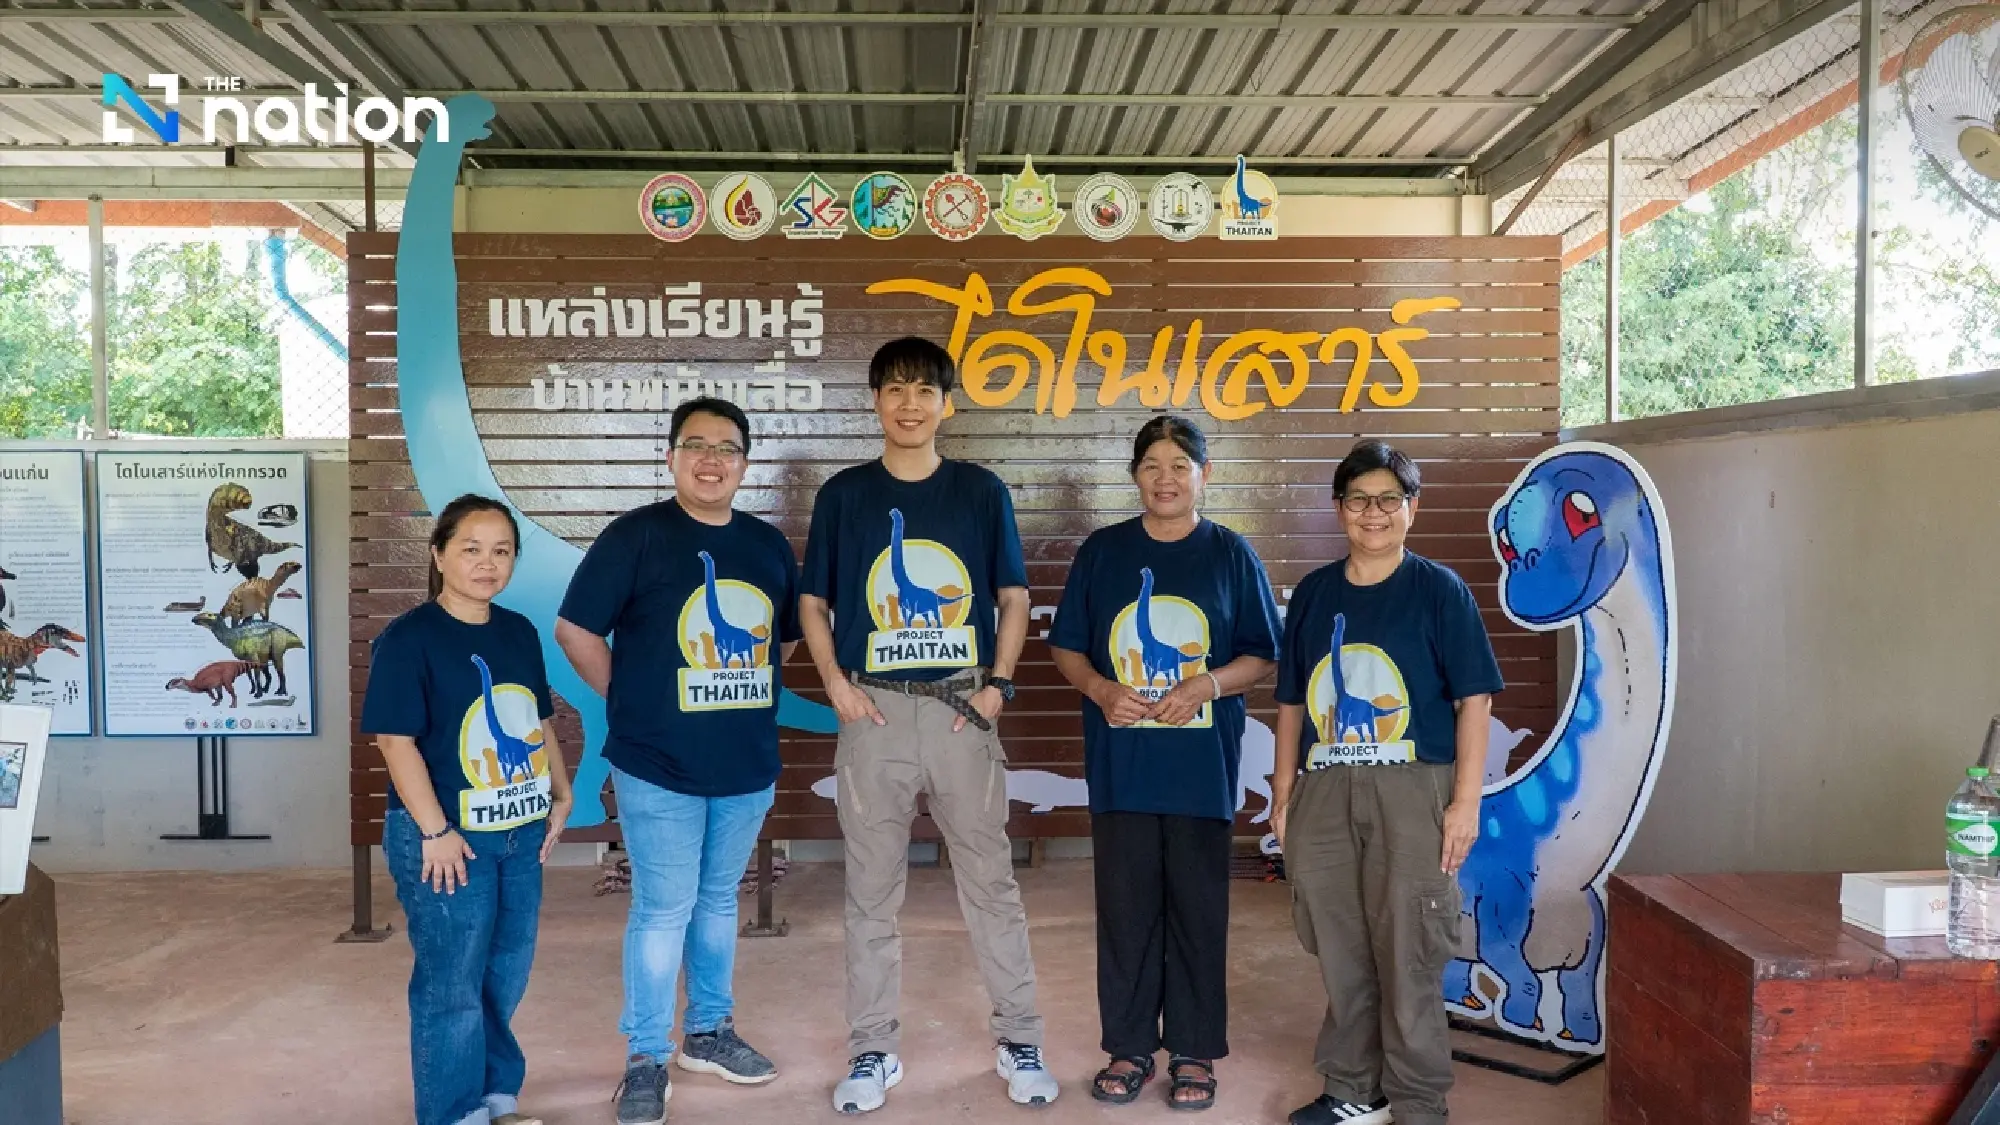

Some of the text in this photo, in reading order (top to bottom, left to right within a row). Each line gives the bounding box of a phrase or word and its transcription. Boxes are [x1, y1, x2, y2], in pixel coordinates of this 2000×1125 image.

[1226, 227, 1272, 235] THAITAN
[489, 281, 823, 356] แหล่งเรียนรู้
[866, 267, 1461, 421] ไดโนเสาร์
[0, 463, 49, 480] นแก่น
[115, 462, 287, 479] ไดโนเสาร์แห่งโคกกรวด
[897, 630, 944, 640] PROJECT
[875, 642, 968, 663] THAITAN
[713, 671, 755, 681] PROJECT
[689, 683, 768, 702] THAITAN
[1328, 745, 1379, 757] PROJECT
[497, 781, 537, 799] PROJECT
[472, 793, 552, 824] THAITA
